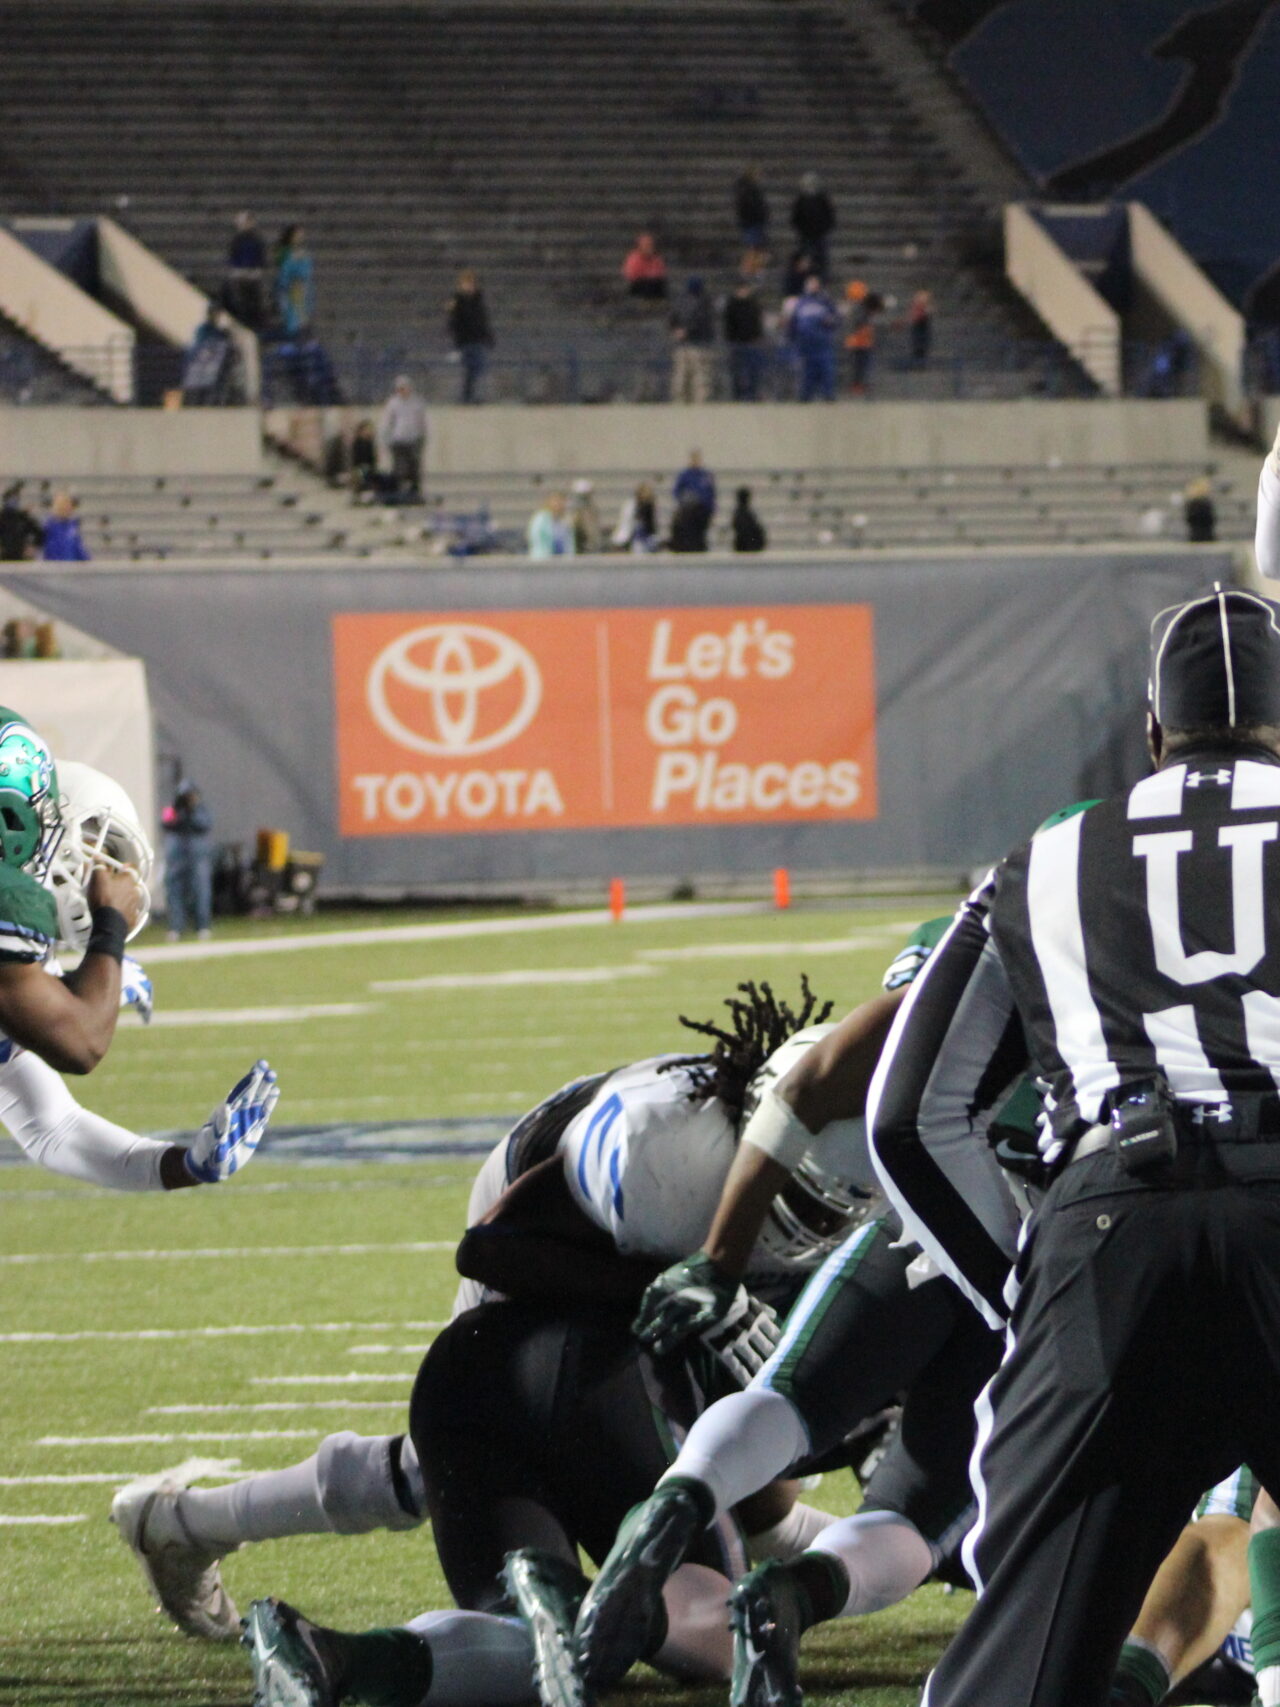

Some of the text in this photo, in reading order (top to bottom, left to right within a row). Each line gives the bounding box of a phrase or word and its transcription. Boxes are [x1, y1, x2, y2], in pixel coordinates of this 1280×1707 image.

[648, 618, 796, 681] Let's
[645, 684, 738, 746] Go
[353, 769, 565, 820] TOYOTA
[650, 751, 862, 813] Places
[1132, 821, 1279, 986] U
